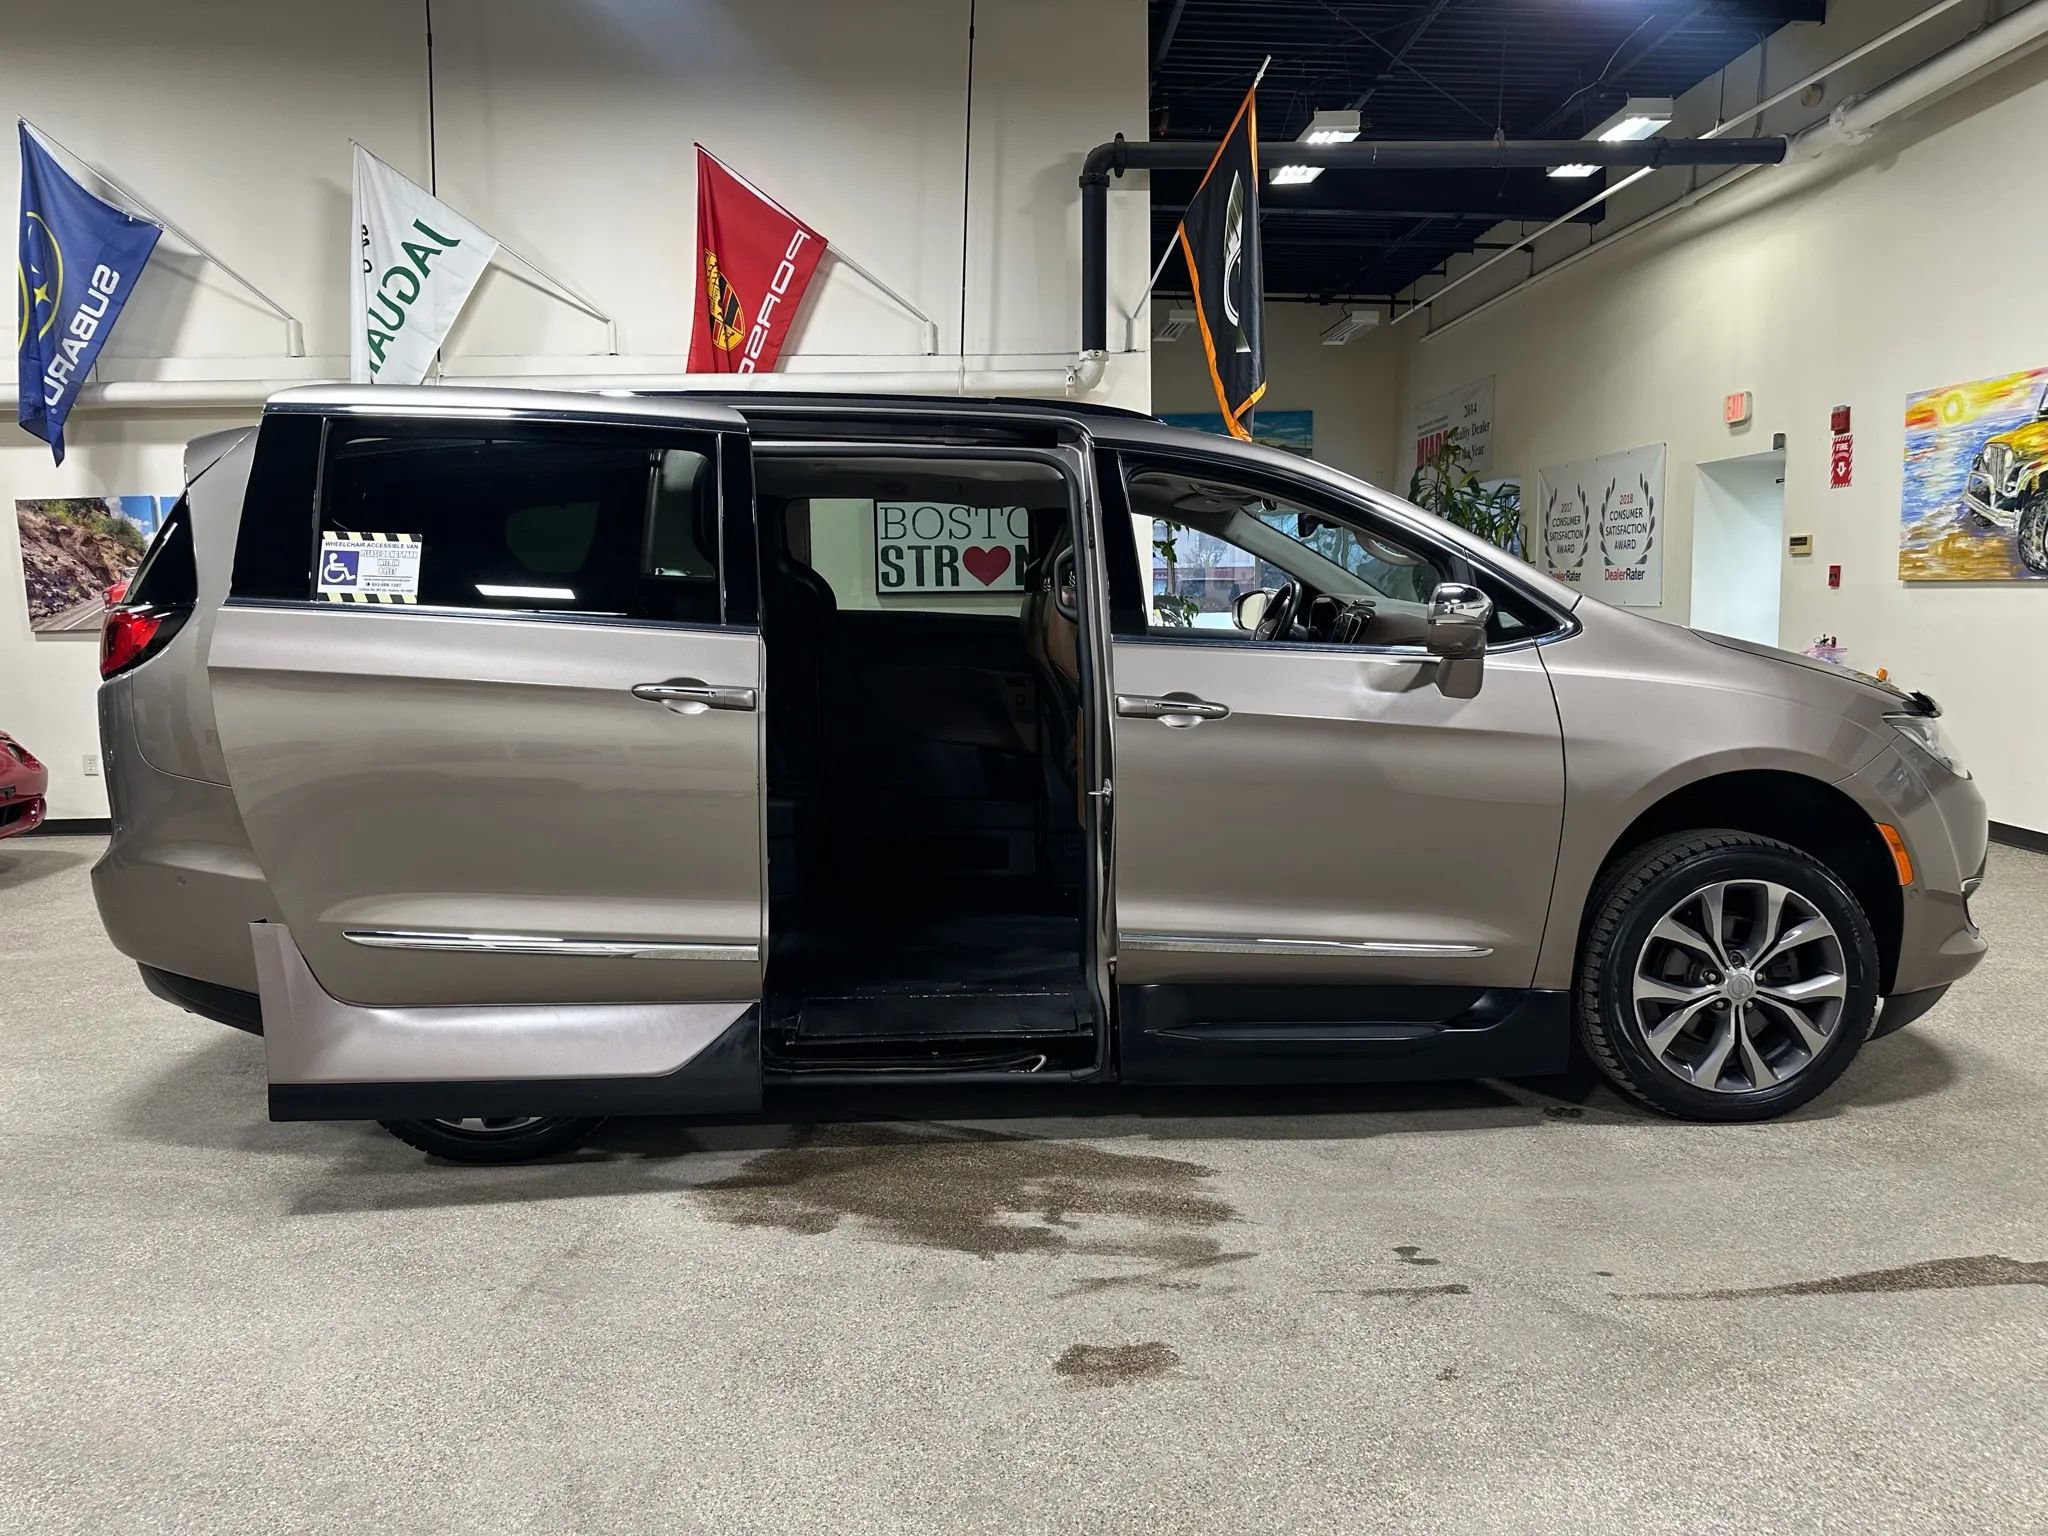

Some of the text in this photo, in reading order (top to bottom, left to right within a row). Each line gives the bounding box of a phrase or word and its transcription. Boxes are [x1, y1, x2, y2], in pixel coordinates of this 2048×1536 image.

[1464, 402, 1477, 418] 2014
[1727, 393, 1744, 420] EXIT
[1471, 420, 1490, 436] Dealer
[1471, 445, 1484, 457] Year
[1836, 443, 1849, 451] FIRE
[1620, 493, 1633, 505] 2018
[1561, 502, 1573, 513] 2017
[1609, 508, 1643, 521] CONSUMER
[1552, 515, 1581, 528] CONSUMER
[1549, 529, 1583, 541] SATISFACTION
[1606, 523, 1647, 536] SATISFACTION
[1556, 543, 1575, 554] AWARD
[1614, 539, 1636, 550] AWARD
[1604, 568, 1645, 581] DealerRater
